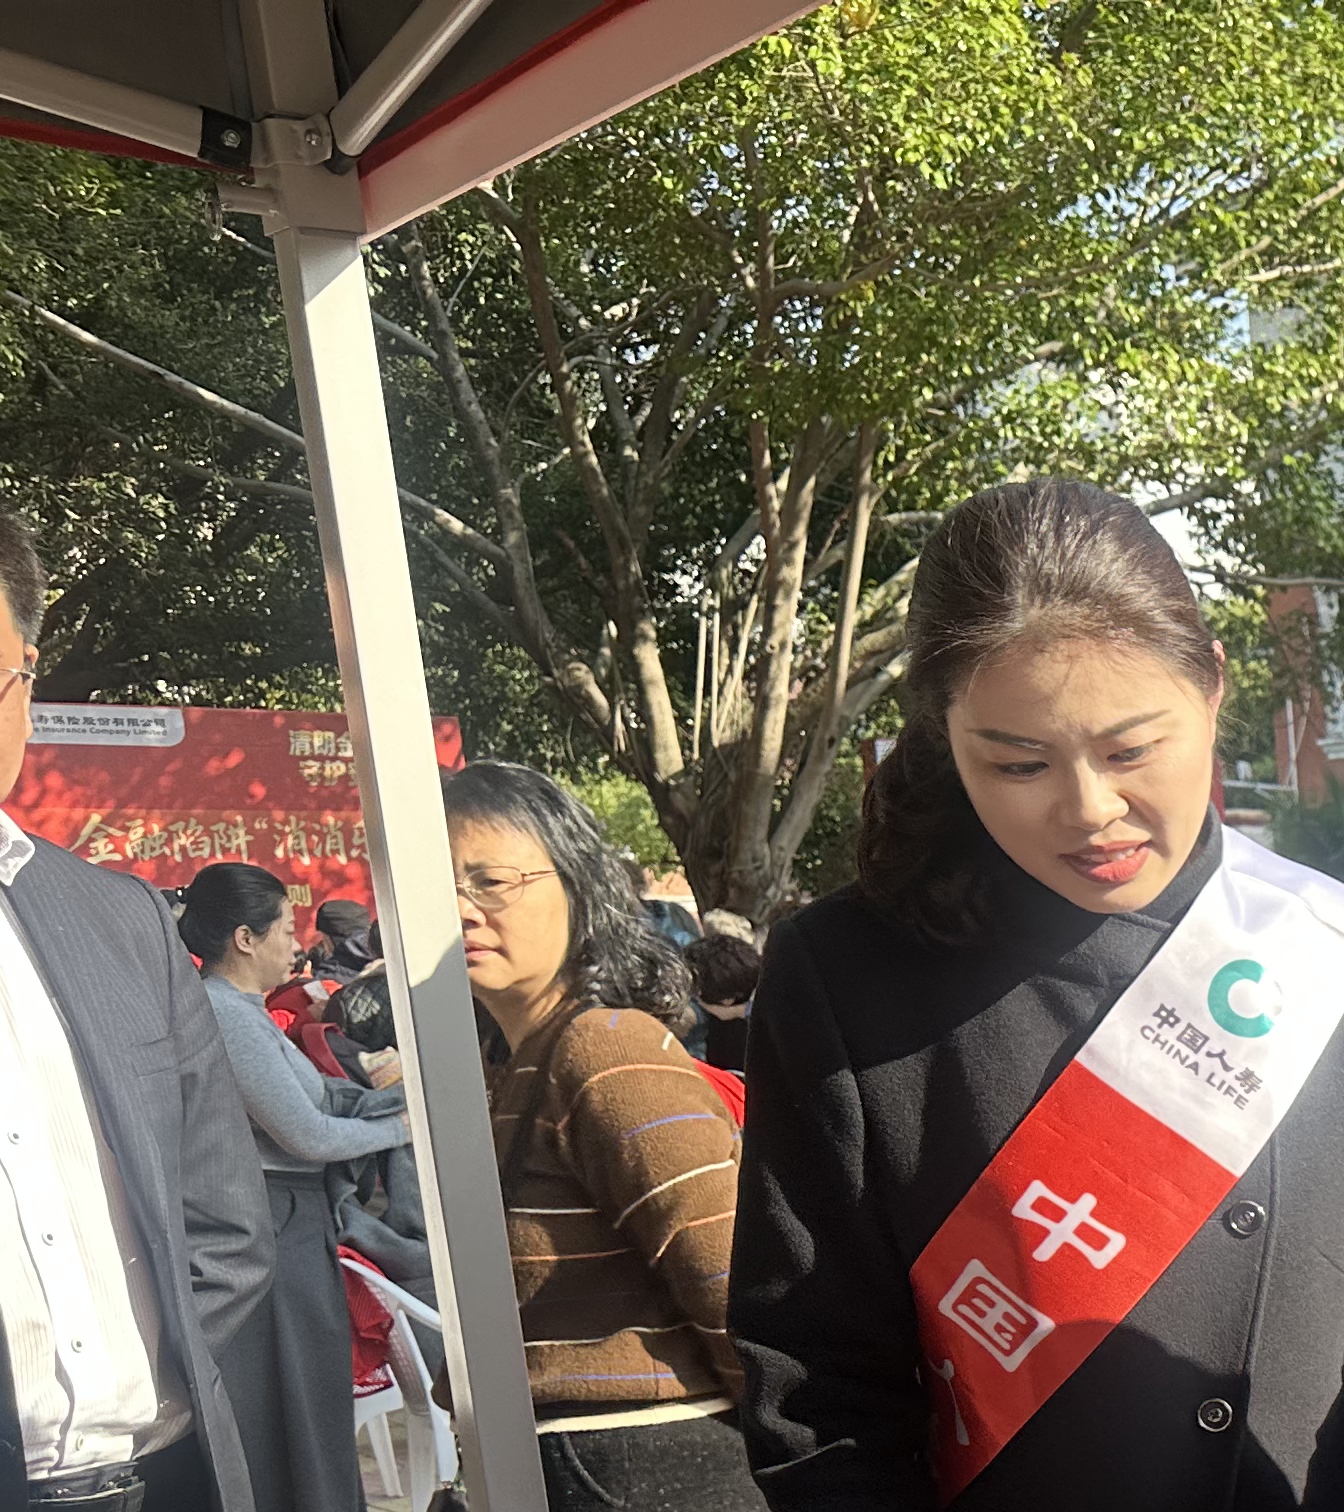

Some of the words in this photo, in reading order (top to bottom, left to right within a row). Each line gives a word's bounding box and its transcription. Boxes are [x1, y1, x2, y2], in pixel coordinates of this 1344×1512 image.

[32, 714, 167, 728] 寿保险股份有限公司
[299, 761, 358, 786] 守护
[1140, 1025, 1202, 1076] CHINA
[1204, 1071, 1250, 1111] LIFE
[1152, 1002, 1264, 1096] 中国人寿
